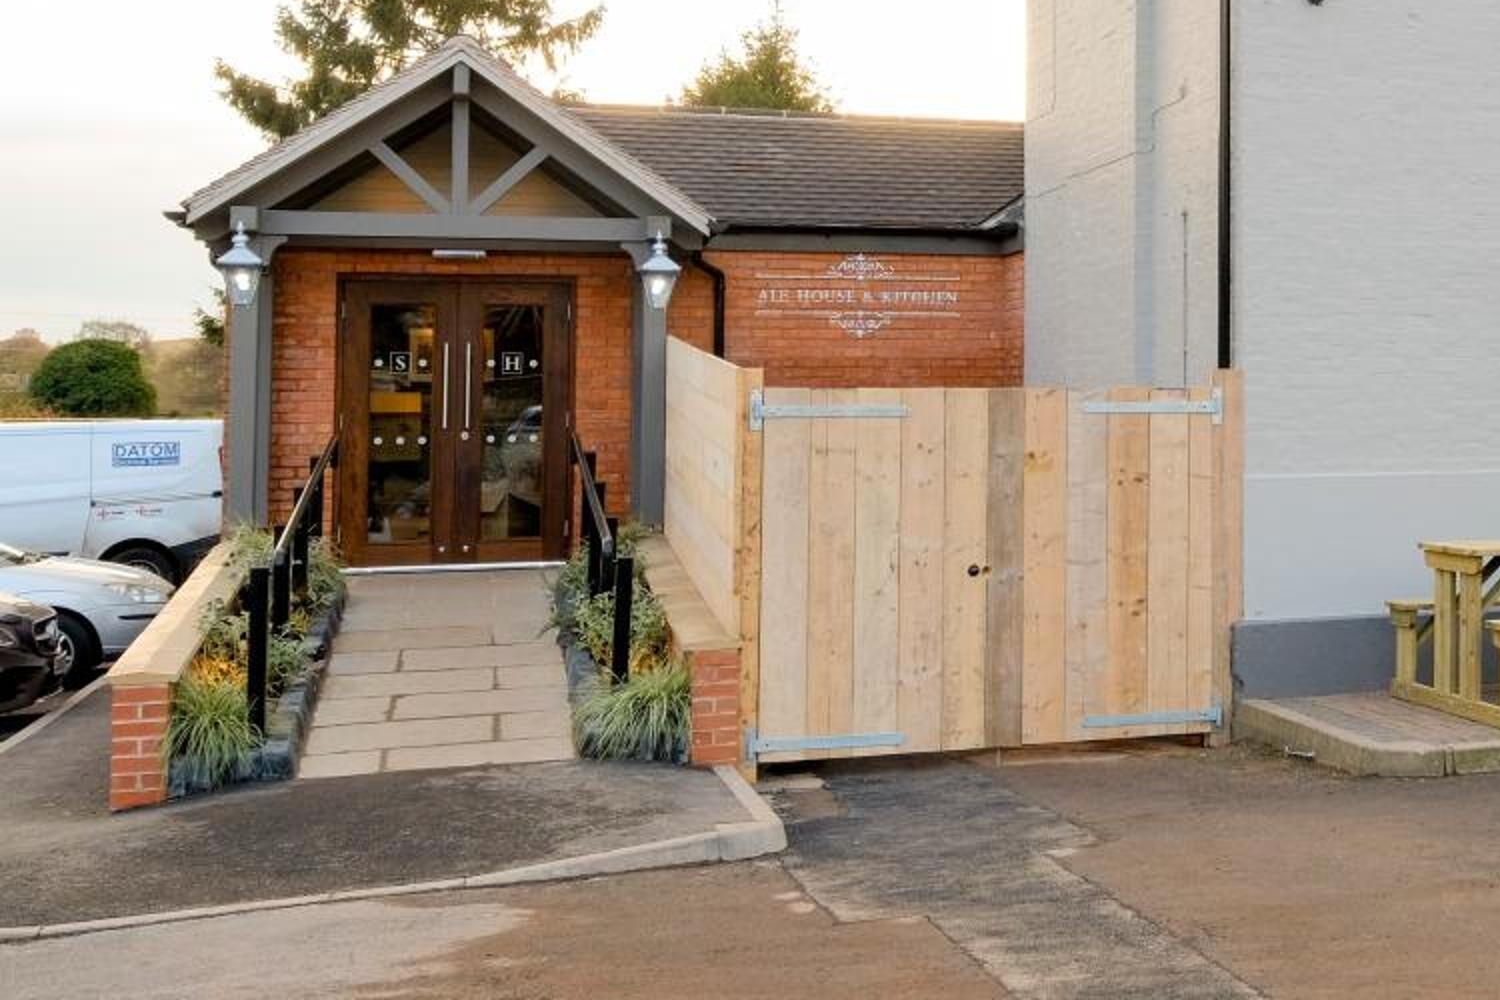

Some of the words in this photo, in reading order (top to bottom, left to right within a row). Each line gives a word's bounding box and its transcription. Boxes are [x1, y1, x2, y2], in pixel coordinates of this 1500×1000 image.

[757, 288, 790, 302] ALE
[797, 289, 858, 303] HOUSE
[880, 291, 960, 304] KITCHEN
[394, 355, 407, 371] S
[505, 355, 521, 371] H
[115, 442, 178, 457] DATOM
